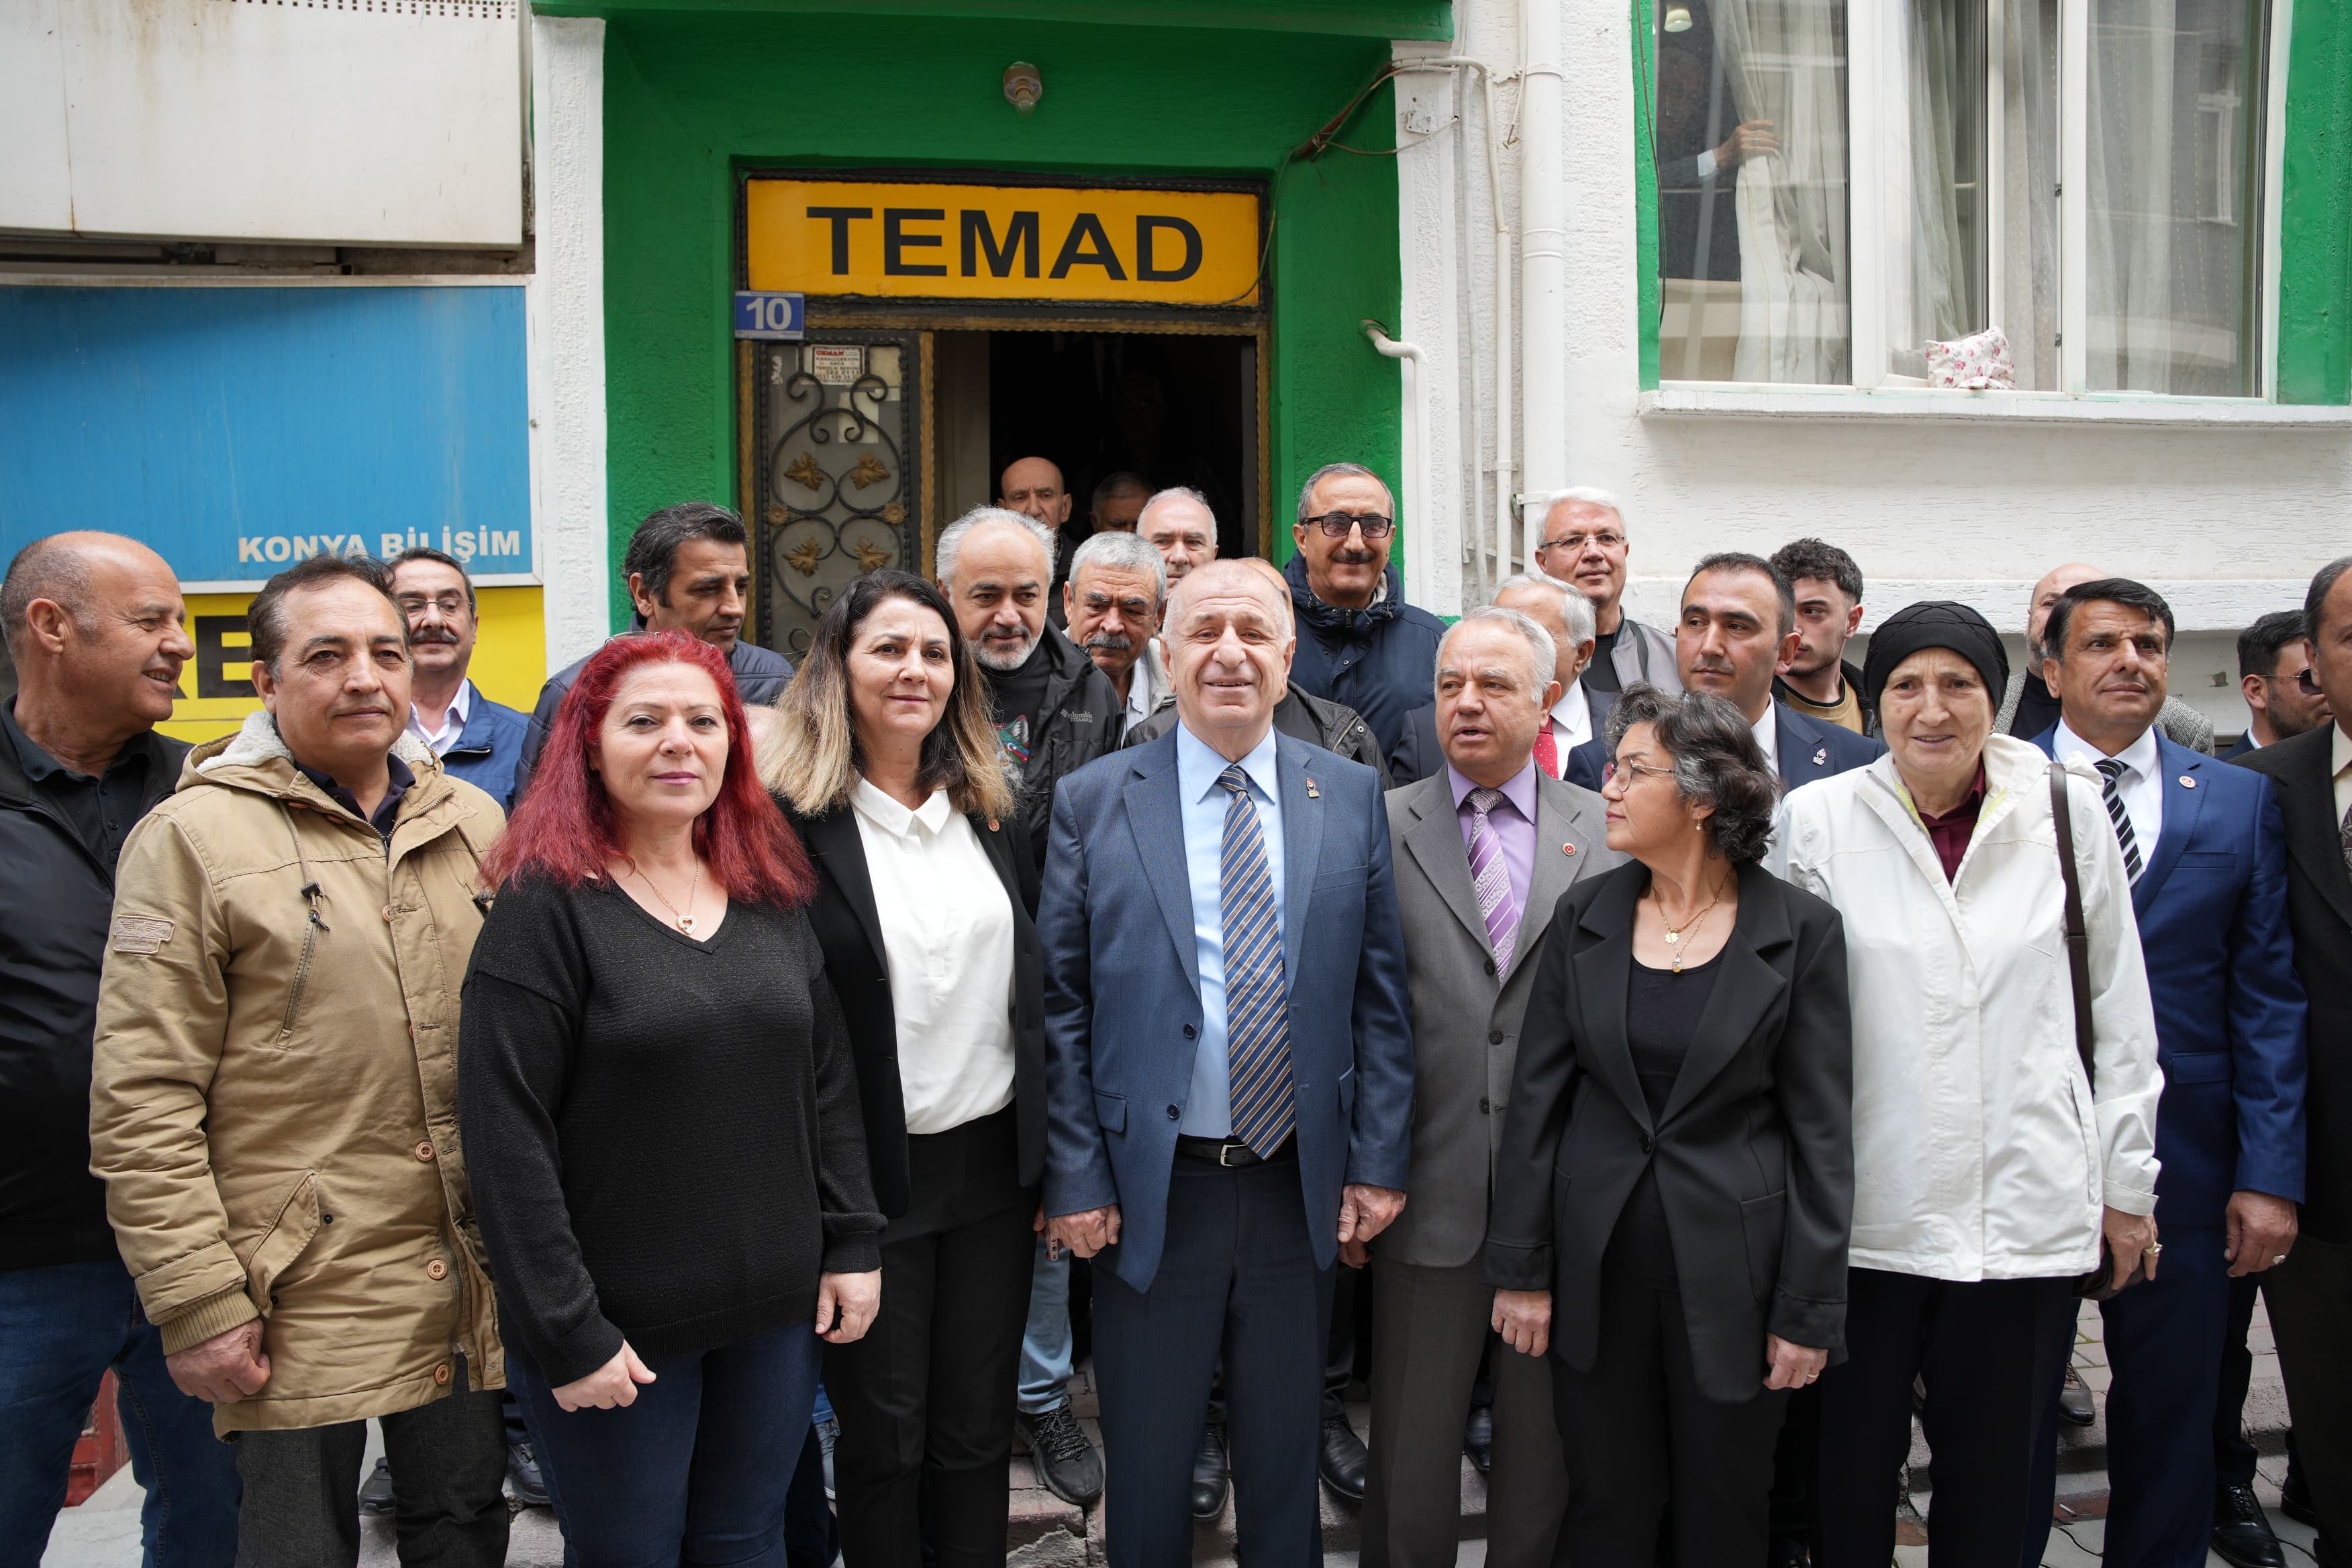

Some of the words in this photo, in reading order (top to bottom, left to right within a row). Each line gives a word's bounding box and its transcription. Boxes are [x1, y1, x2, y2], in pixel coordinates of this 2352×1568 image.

[807, 207, 1204, 282] TEMAD
[746, 297, 791, 330] 10
[239, 534, 369, 563] KONYA
